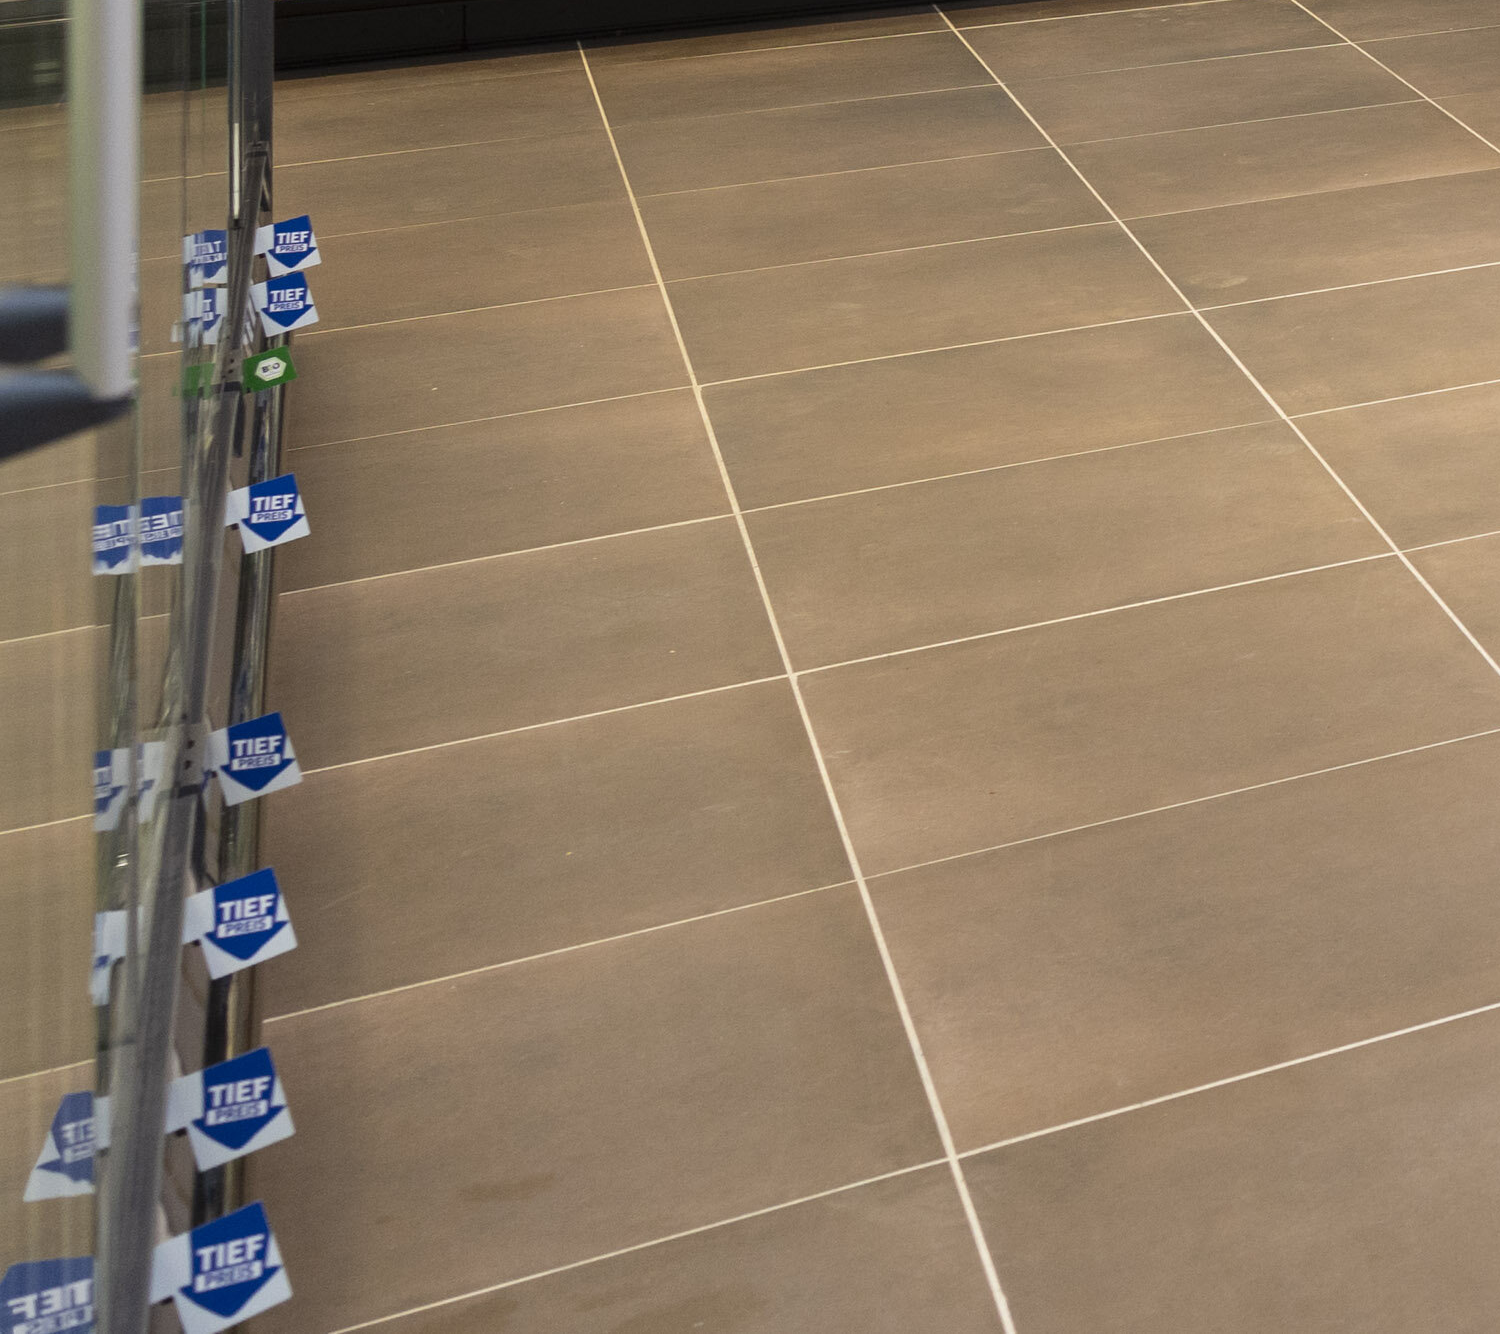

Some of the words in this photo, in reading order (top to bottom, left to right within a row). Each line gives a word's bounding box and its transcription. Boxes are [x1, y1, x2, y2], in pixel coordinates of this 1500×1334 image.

[274, 229, 308, 247] TIEF
[275, 243, 308, 258] PREIS
[268, 286, 306, 303] TIEF
[270, 299, 306, 313] PREIS
[248, 492, 295, 513] TIEF
[252, 508, 293, 526] PREIS
[230, 733, 281, 756] TIEF
[230, 751, 281, 769] PREIS
[218, 895, 275, 924] TIEF
[218, 915, 272, 938] PREIS
[207, 1073, 272, 1105] TIEF
[205, 1096, 268, 1125] PREIS
[196, 1233, 266, 1273] TIEF
[194, 1260, 265, 1289] PREIS
